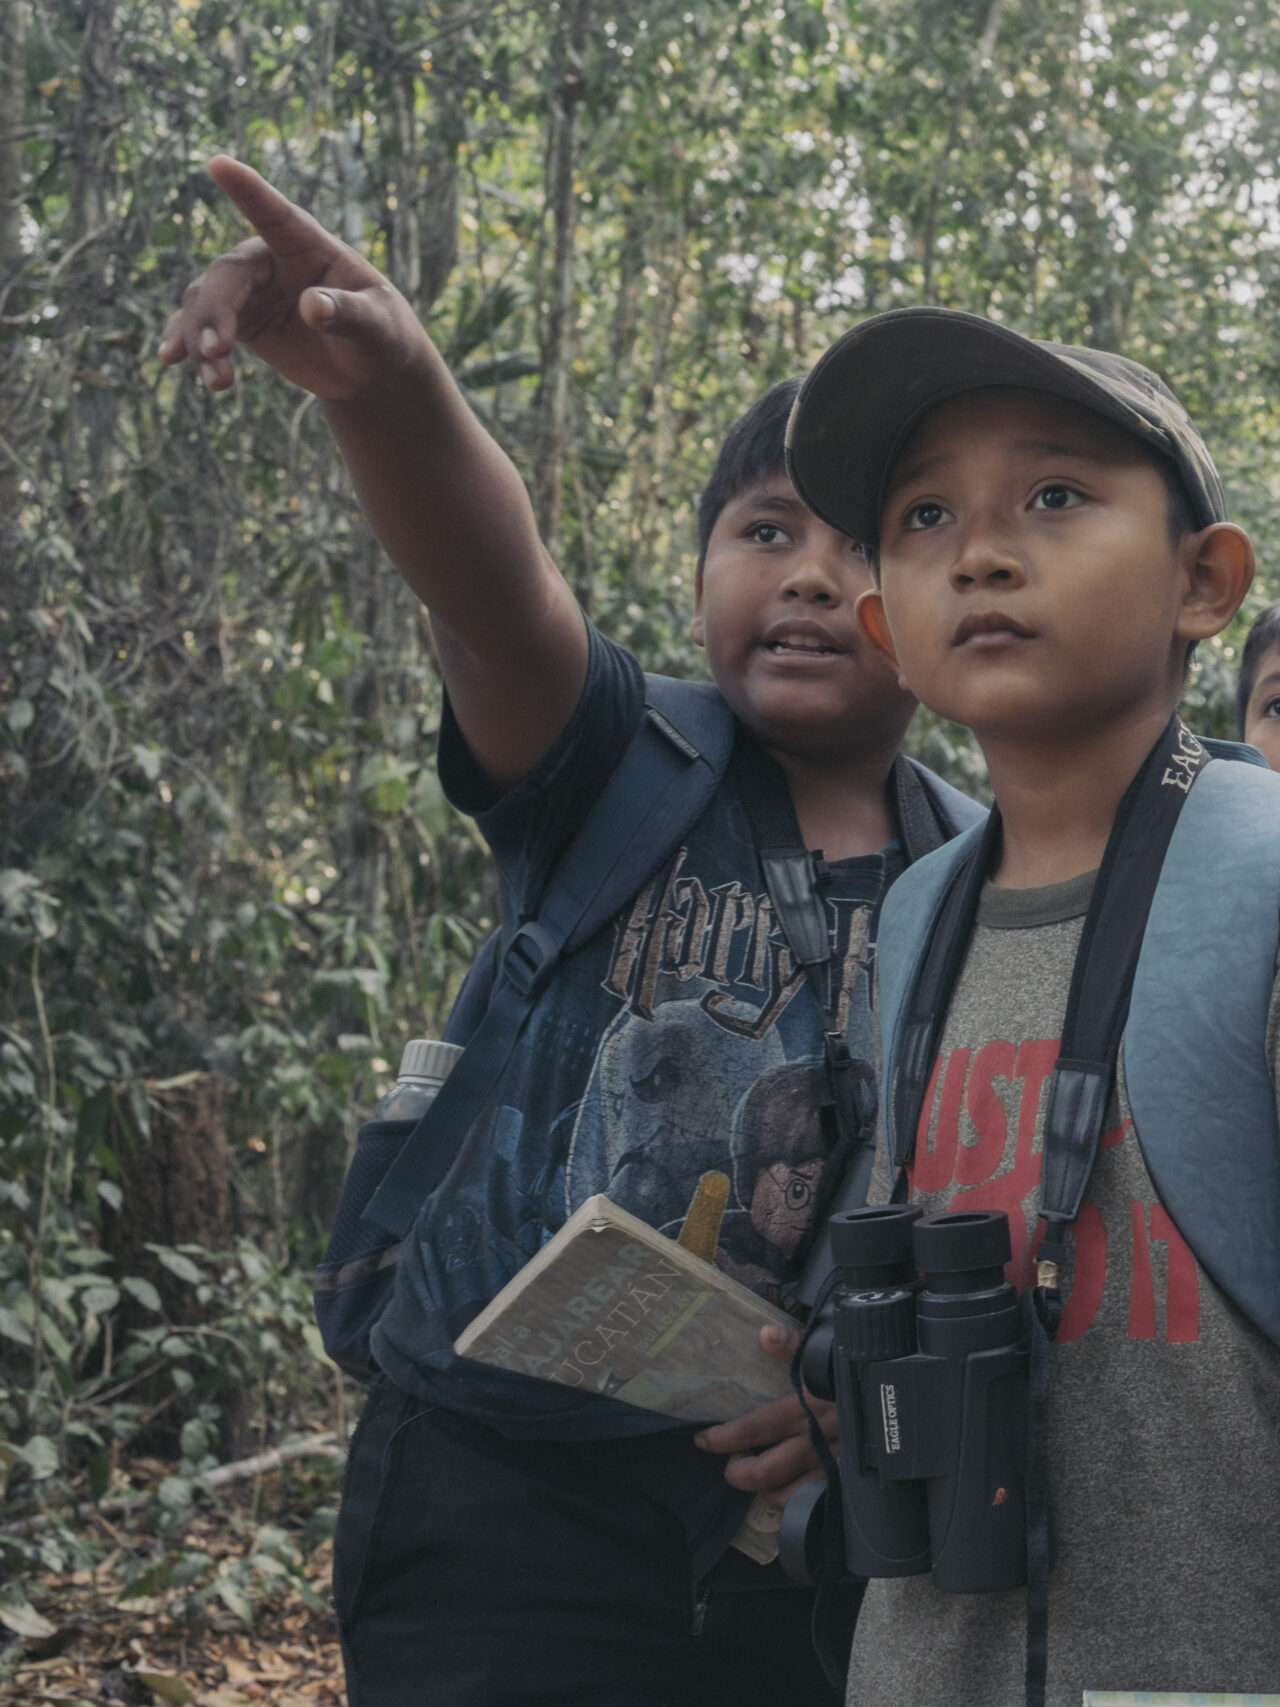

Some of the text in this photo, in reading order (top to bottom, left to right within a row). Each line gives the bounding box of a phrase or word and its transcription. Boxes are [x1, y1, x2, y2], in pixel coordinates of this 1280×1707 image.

[906, 1039, 1062, 1196] UST
[513, 1242, 653, 1377] AJAREAR
[513, 1324, 531, 1339] a
[1127, 1199, 1199, 1344] IT
[886, 1384, 901, 1450] EAGLE OPTICS
